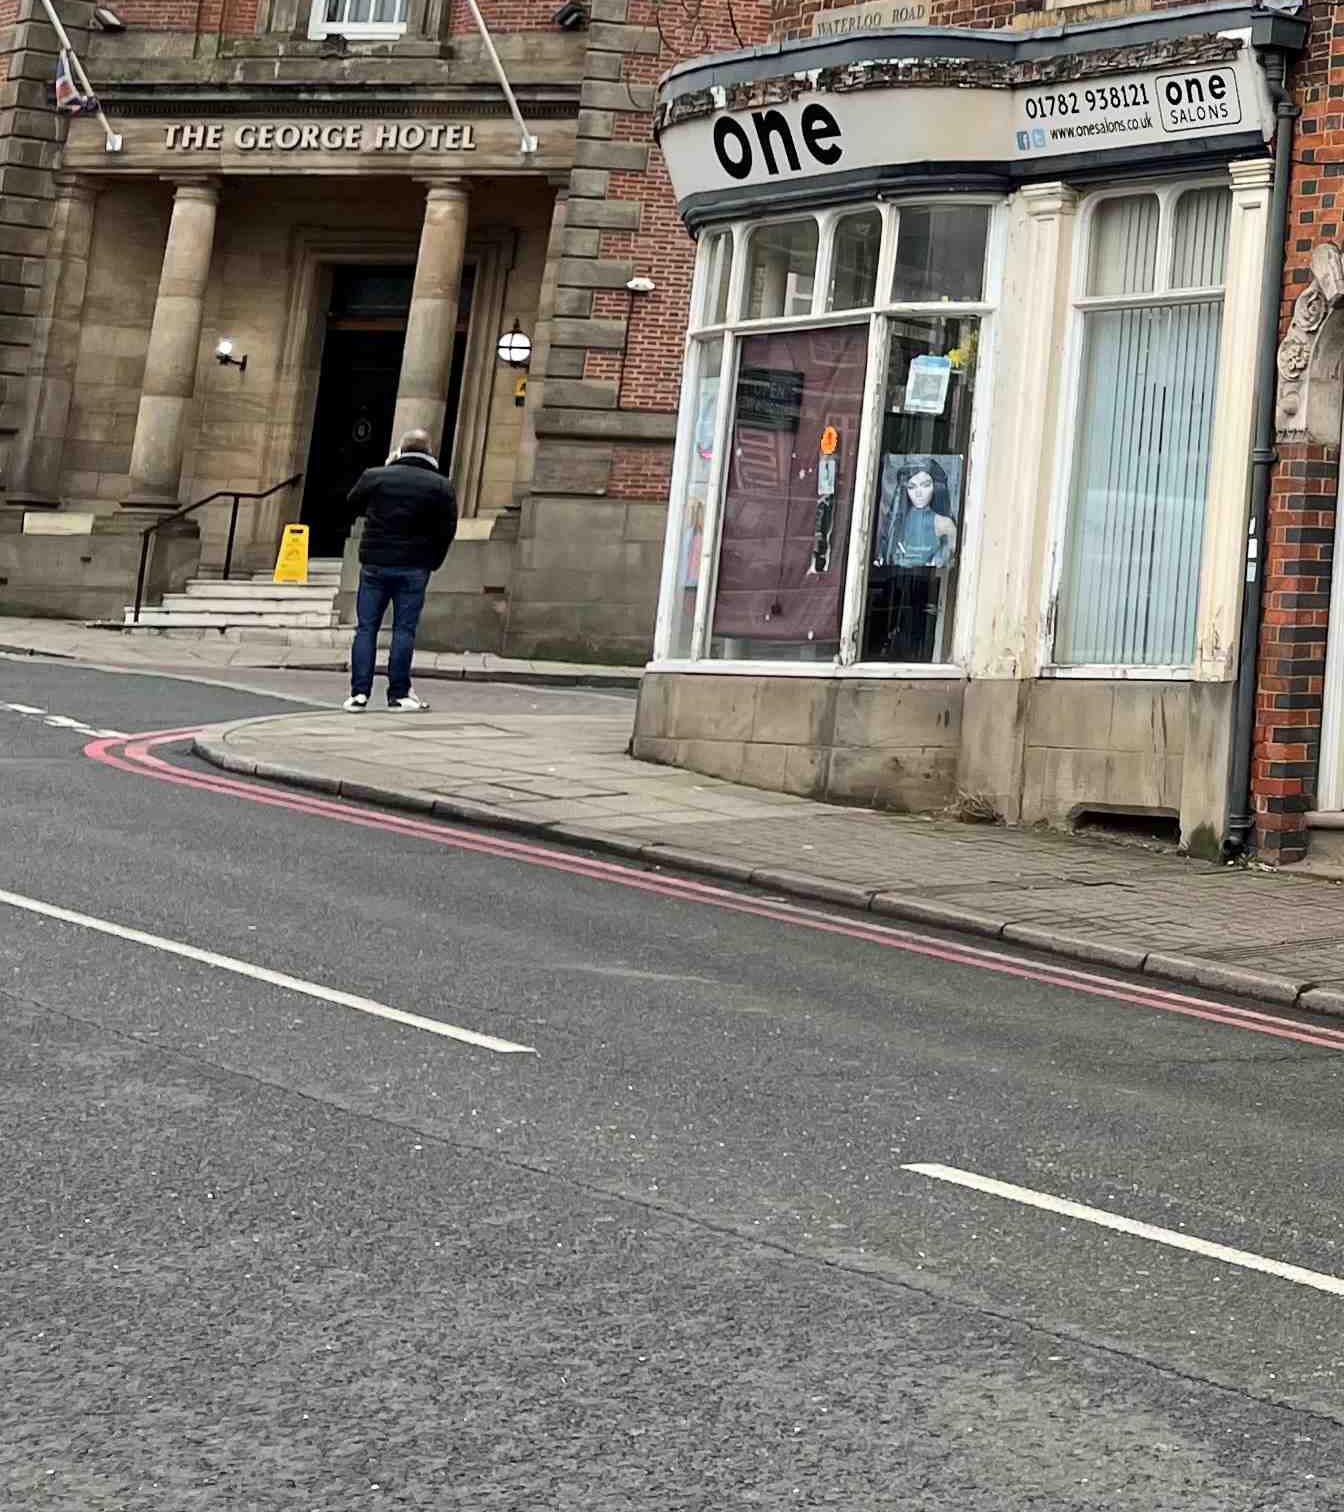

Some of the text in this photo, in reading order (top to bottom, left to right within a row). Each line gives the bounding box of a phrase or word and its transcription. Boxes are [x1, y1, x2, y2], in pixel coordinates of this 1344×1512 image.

[816, 4, 926, 37] WATERLOO ROAD
[1025, 83, 1150, 120] 01782 938121
[1165, 74, 1226, 106] one
[1050, 112, 1153, 141] www.onesalons.co.uk
[1170, 102, 1229, 125] SALONS
[164, 123, 477, 151] THE GEORGE HOTEL
[713, 103, 843, 180] one
